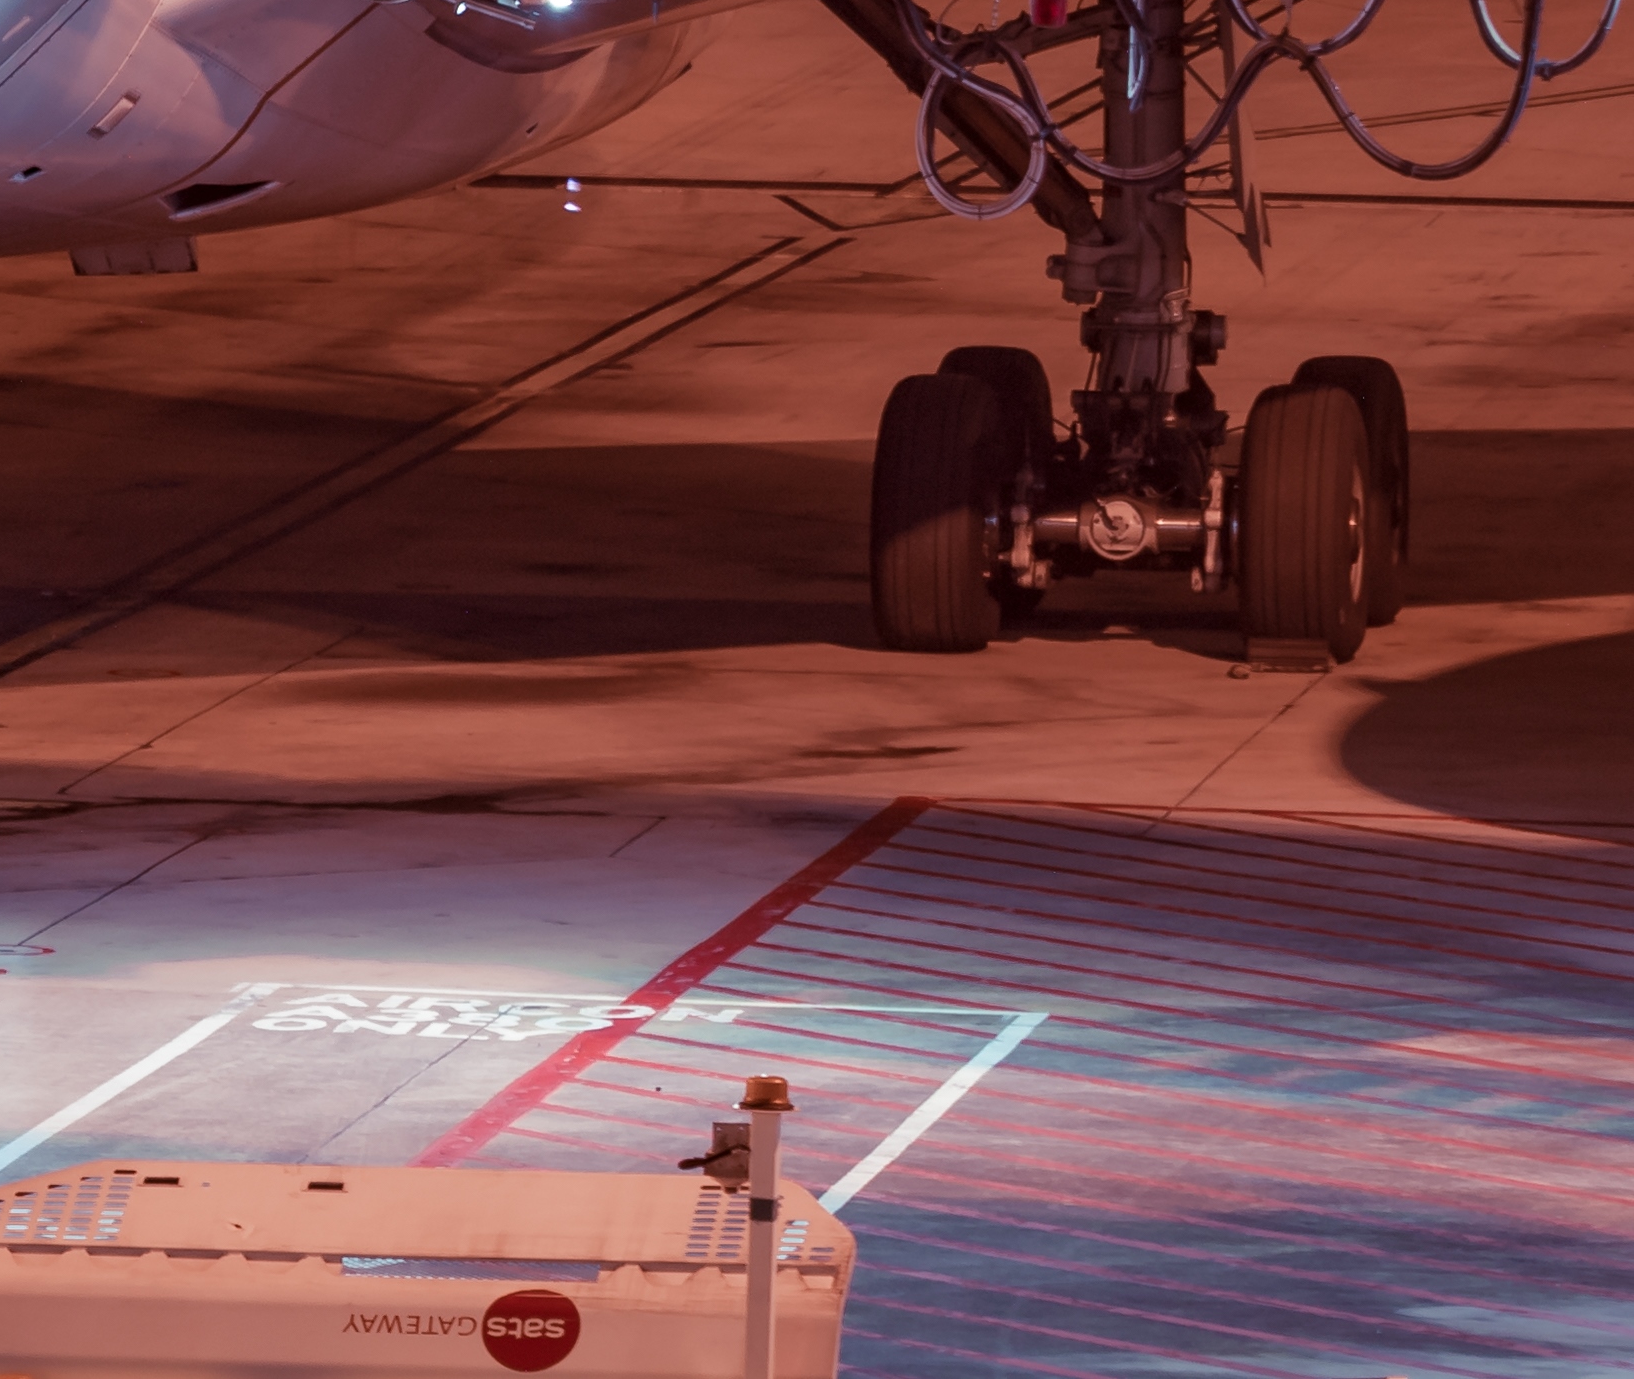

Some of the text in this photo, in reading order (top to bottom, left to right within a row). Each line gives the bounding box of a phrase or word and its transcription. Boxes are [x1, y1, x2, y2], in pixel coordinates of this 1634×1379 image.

[283, 993, 743, 1023] AIRCON
[252, 1017, 580, 1041] ONLY
[342, 1313, 566, 1339] sats GATEWAY
